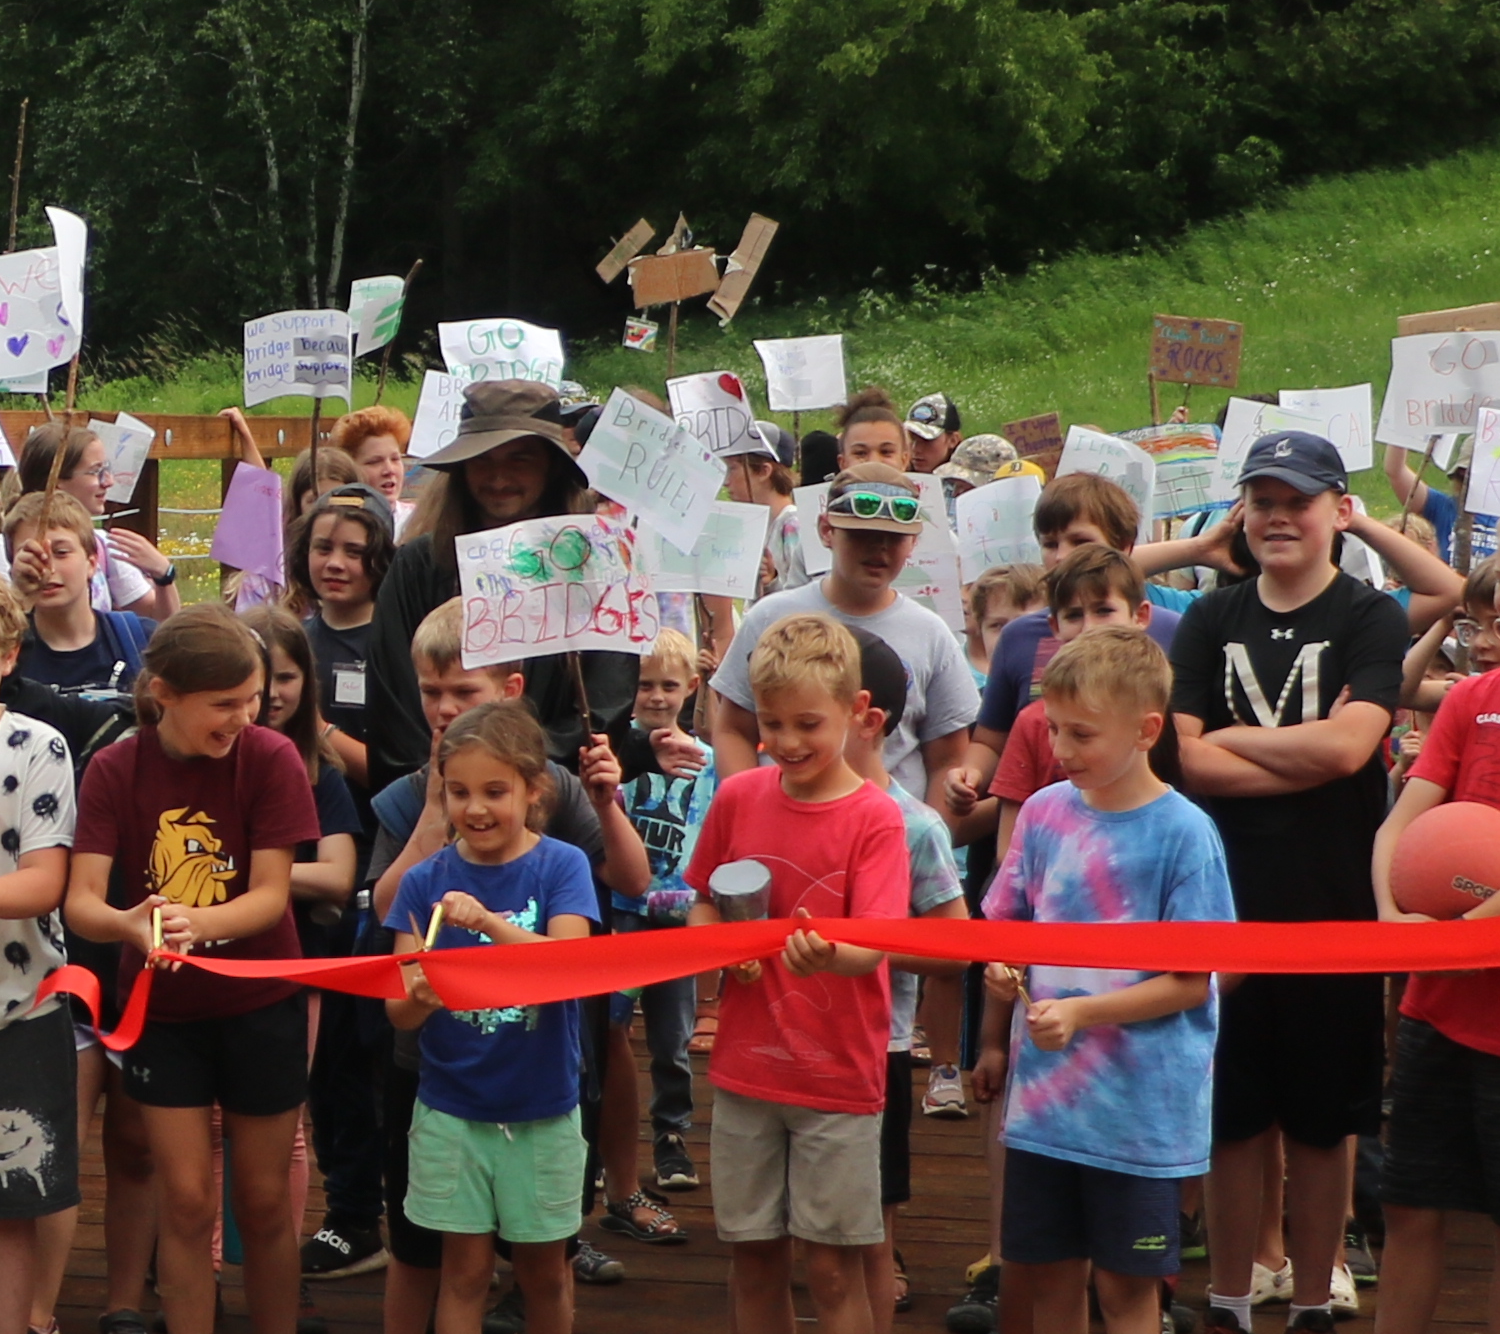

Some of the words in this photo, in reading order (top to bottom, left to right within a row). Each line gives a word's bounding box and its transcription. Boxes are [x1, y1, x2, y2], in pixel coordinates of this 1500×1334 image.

[467, 321, 524, 356] GO
[1167, 344, 1225, 373] ROCKS
[1429, 338, 1488, 376] GO
[612, 398, 686, 455] Bridges
[619, 442, 697, 517] RULE!
[508, 524, 592, 579] GO
